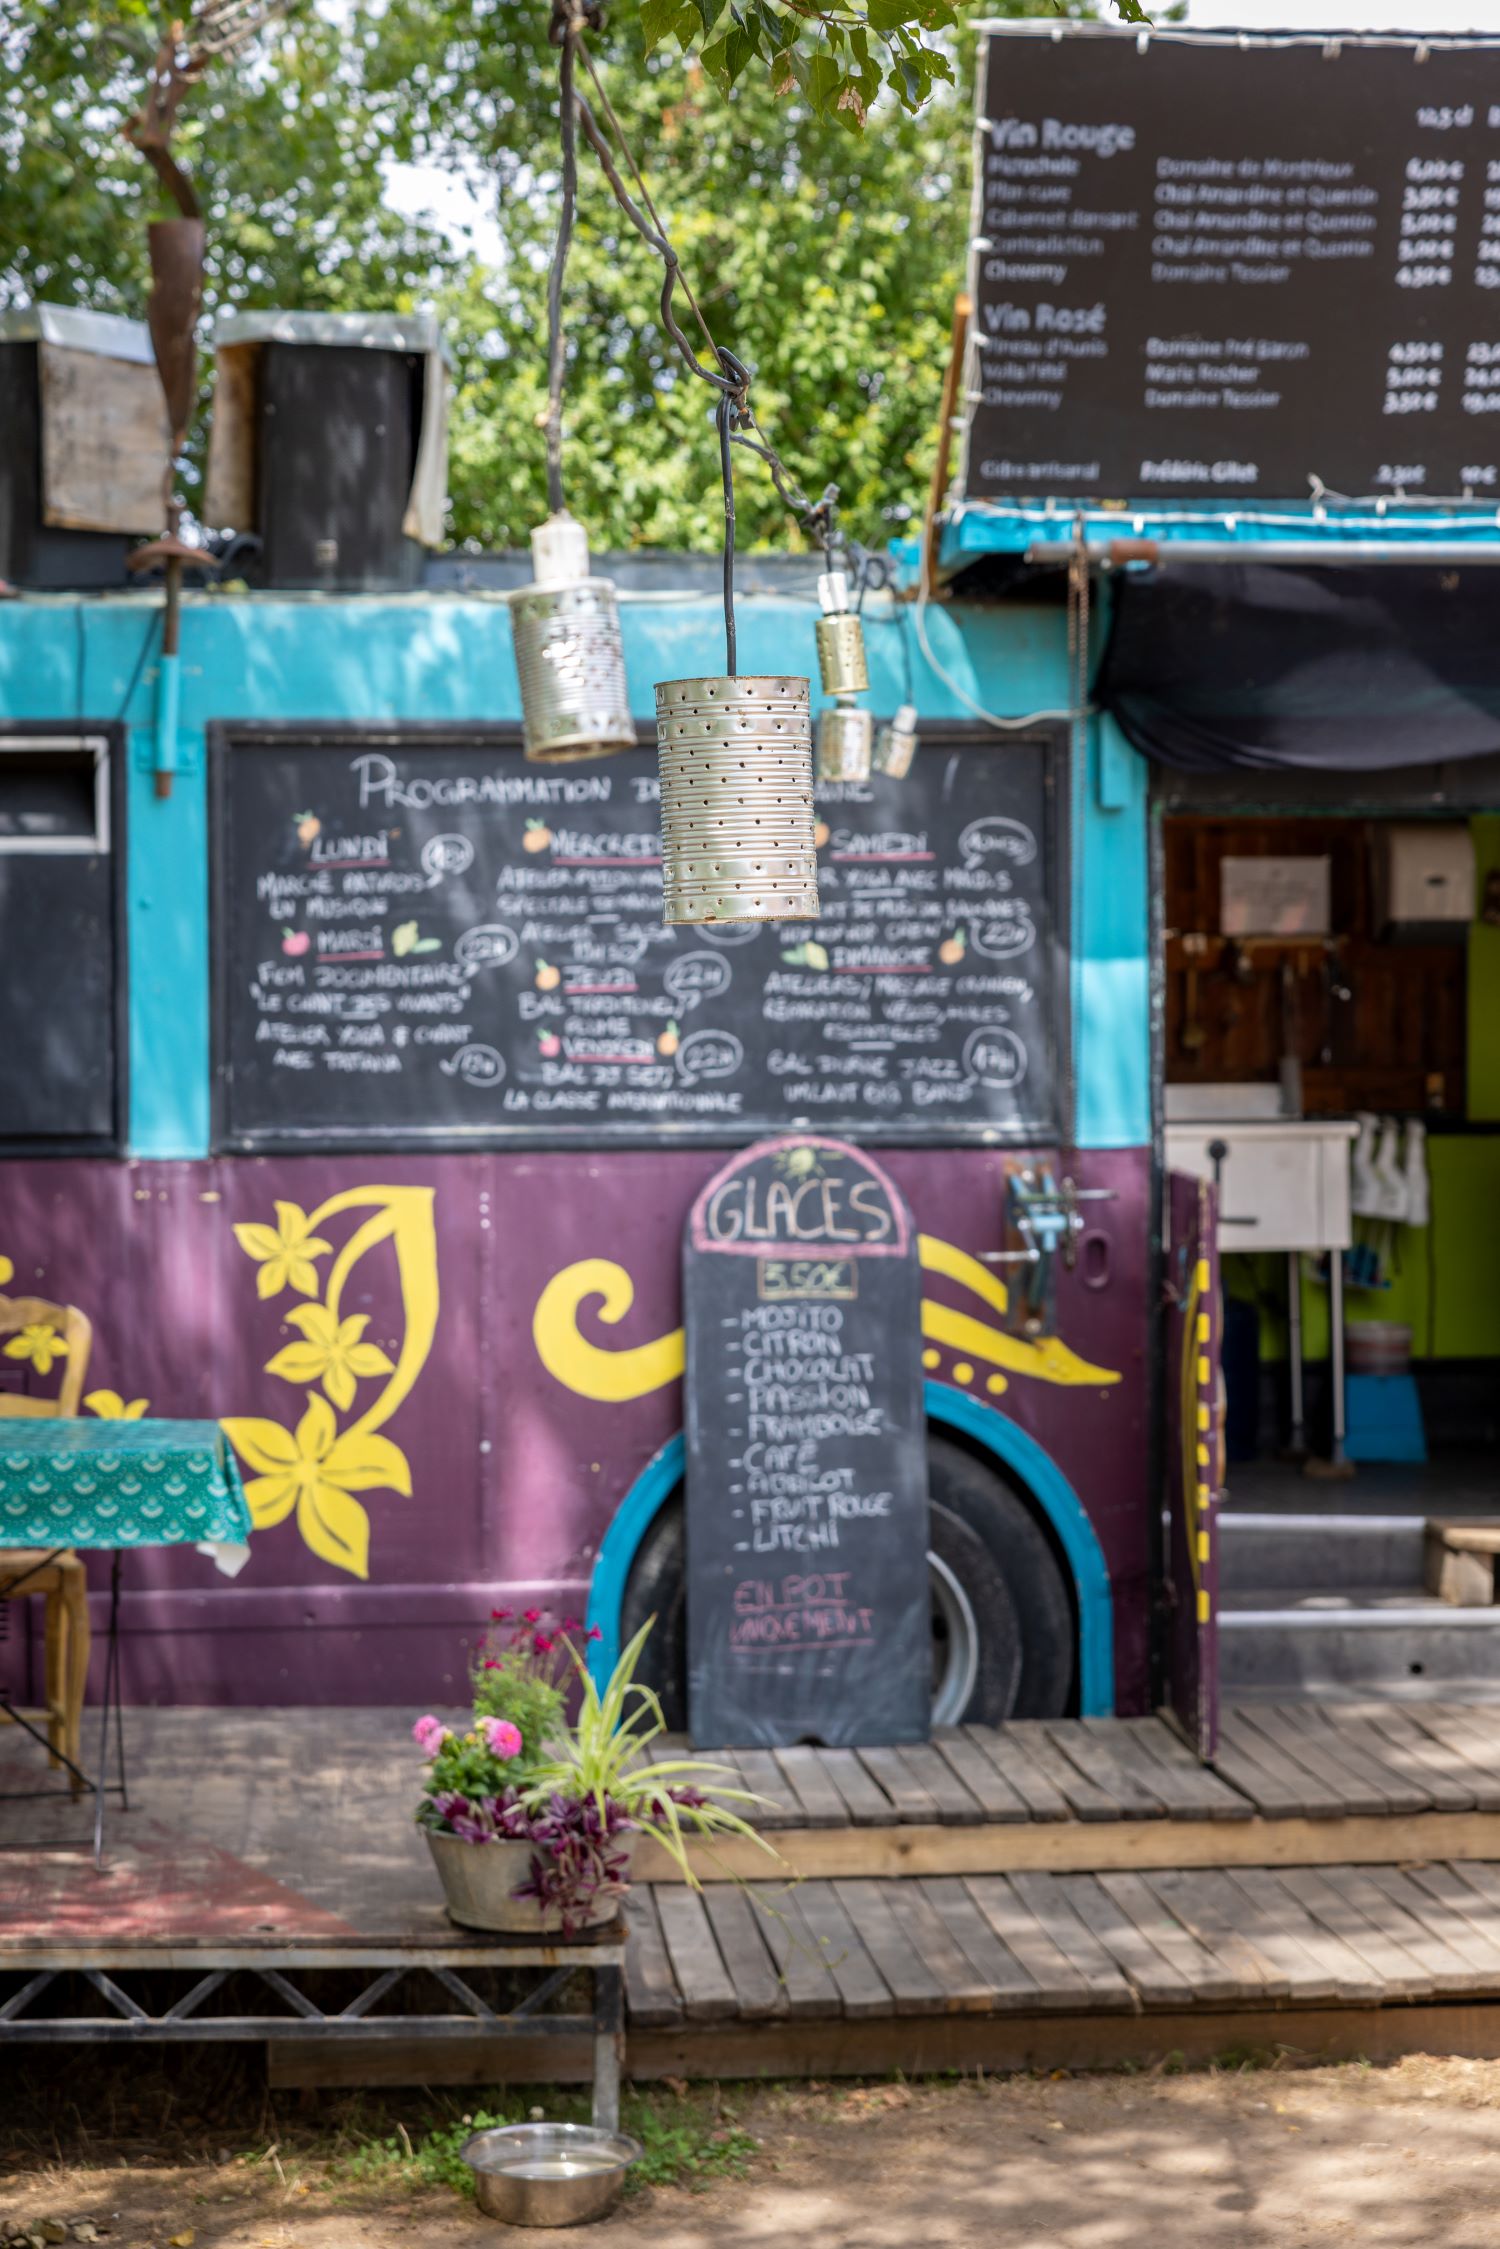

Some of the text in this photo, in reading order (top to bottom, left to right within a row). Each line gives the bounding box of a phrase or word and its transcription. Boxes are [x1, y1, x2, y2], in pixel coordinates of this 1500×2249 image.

[991, 118, 1136, 158] Vin Rouge
[984, 259, 1068, 286] Cheverny
[984, 302, 1106, 333] Vin Rosé
[982, 386, 1063, 411] Cheverny
[350, 753, 612, 809] PROGRAMMATION
[310, 829, 388, 863] LUNDI
[551, 828, 663, 858] MERCRED
[830, 828, 927, 853] SAMEDI
[305, 896, 389, 920] MUSIQUE
[317, 925, 384, 952] MARDI
[832, 944, 932, 968] DIMANCHE
[313, 962, 467, 988] DOCUMENTAIRE
[255, 1018, 331, 1046] ATELIER
[337, 1023, 385, 1046] YOGA
[561, 1036, 655, 1058] VENDREDI
[898, 1056, 962, 1080] JAZZ
[708, 1176, 891, 1242] GLACES
[740, 1302, 845, 1333] MOJITO
[742, 1329, 842, 1357] CITRON
[744, 1353, 875, 1386] CHOCOLAT
[748, 1374, 871, 1413] PASSION
[748, 1408, 884, 1442] FRAMBOISE
[747, 1468, 855, 1496] ABRICOT
[750, 1495, 823, 1525] FRUIT
[753, 1518, 840, 1553] LITCHI
[733, 1572, 851, 1612] EN POT
